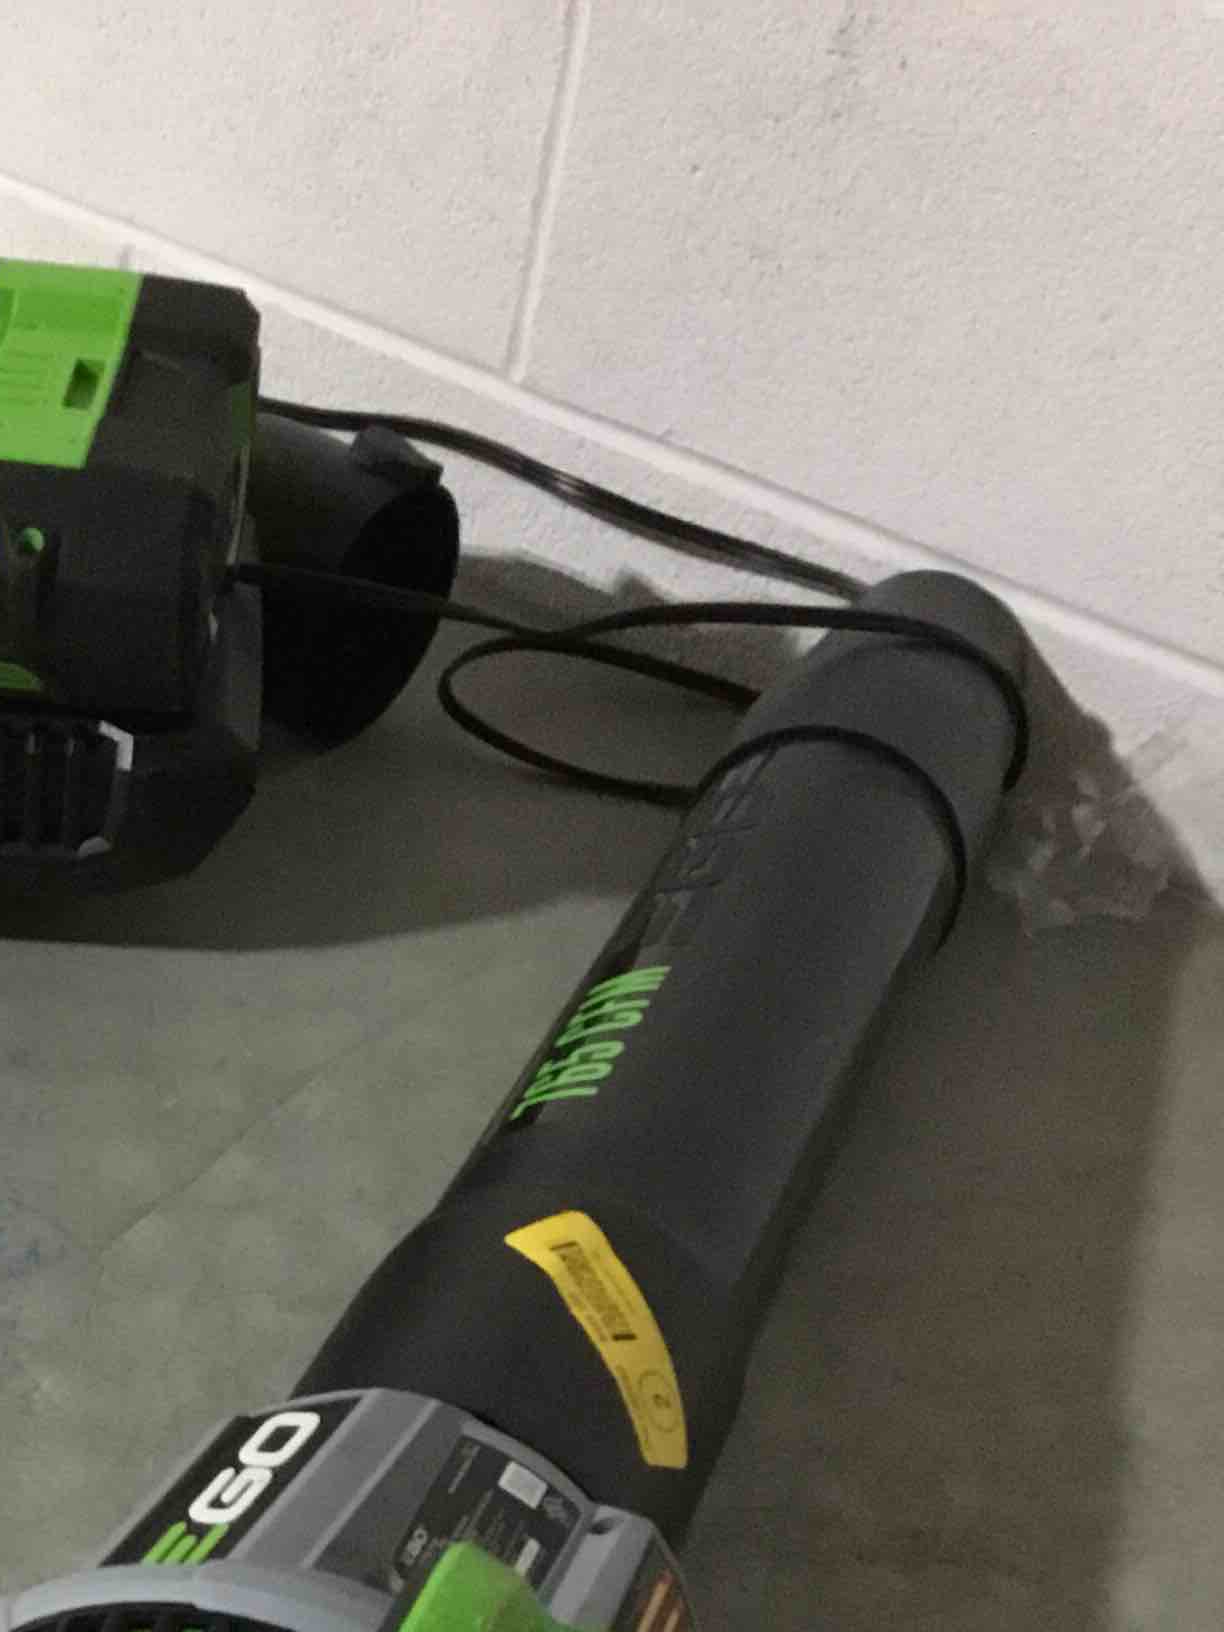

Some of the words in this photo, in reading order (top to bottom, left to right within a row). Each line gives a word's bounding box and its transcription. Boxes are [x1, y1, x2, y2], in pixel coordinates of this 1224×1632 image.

[555, 965, 672, 1046] CFM
[511, 1041, 624, 1120] 765
[140, 1411, 321, 1567] EGO
